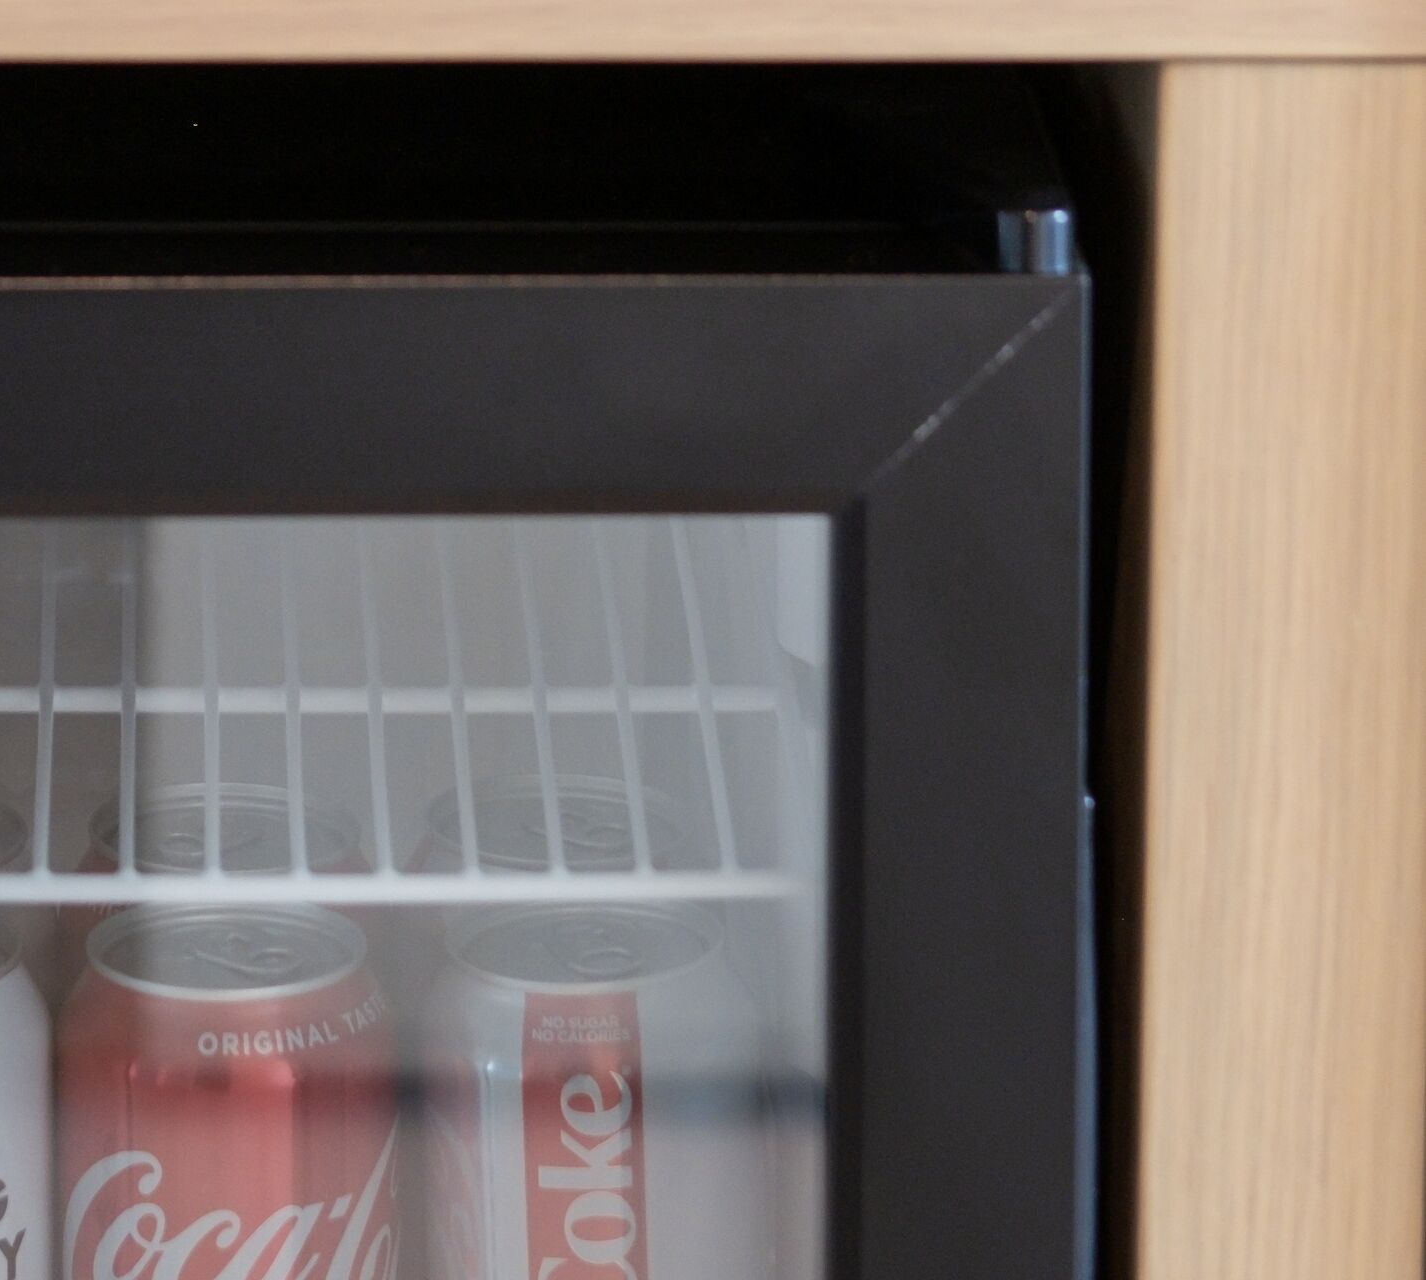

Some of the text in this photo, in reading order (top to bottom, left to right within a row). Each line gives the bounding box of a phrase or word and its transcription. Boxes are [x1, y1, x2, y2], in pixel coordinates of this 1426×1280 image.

[541, 1015, 620, 1029] NO SUGAR
[197, 1020, 342, 1057] ORIGINAL
[531, 1028, 631, 1041] NO CALORIES
